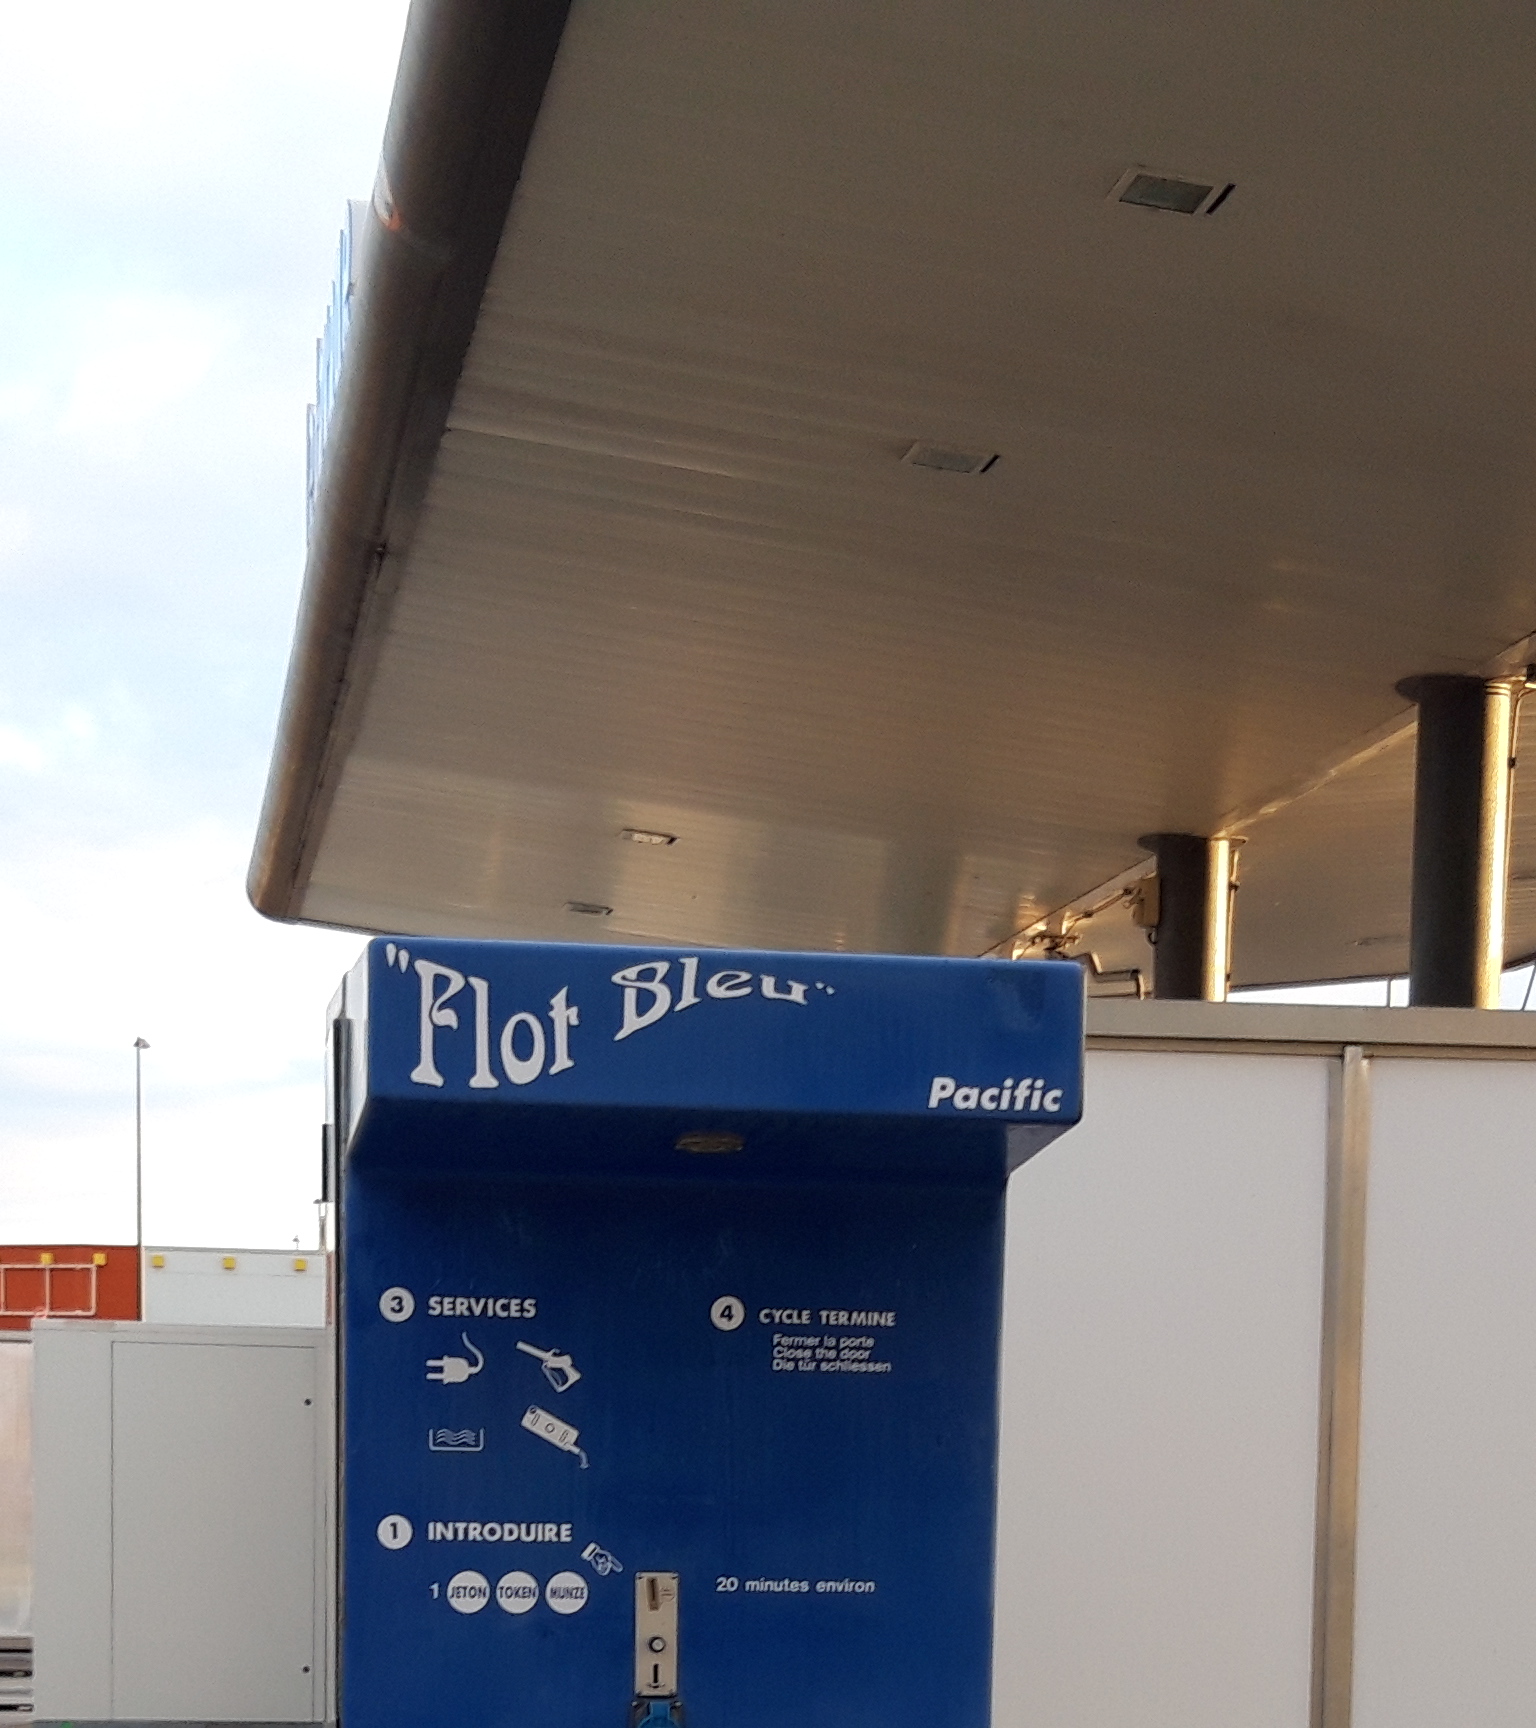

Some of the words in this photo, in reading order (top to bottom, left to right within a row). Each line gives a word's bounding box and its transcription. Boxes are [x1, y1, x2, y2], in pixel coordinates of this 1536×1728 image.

[927, 1075, 1063, 1113] Pacific
[427, 1295, 539, 1319] SERVICES
[758, 1307, 812, 1325] CYCLE
[818, 1309, 897, 1328] TERMINE
[772, 1332, 821, 1347] Fermer
[839, 1336, 876, 1351] porte
[772, 1346, 813, 1359] Close
[815, 1347, 838, 1360] the
[839, 1348, 872, 1361] door
[772, 1359, 795, 1372] Die
[427, 1521, 574, 1543] INTRODUIRE
[450, 1585, 489, 1600] JETON
[498, 1585, 538, 1600] TOKEN
[715, 1576, 740, 1592] 20
[744, 1577, 810, 1593] minutes
[815, 1579, 876, 1594] environ
